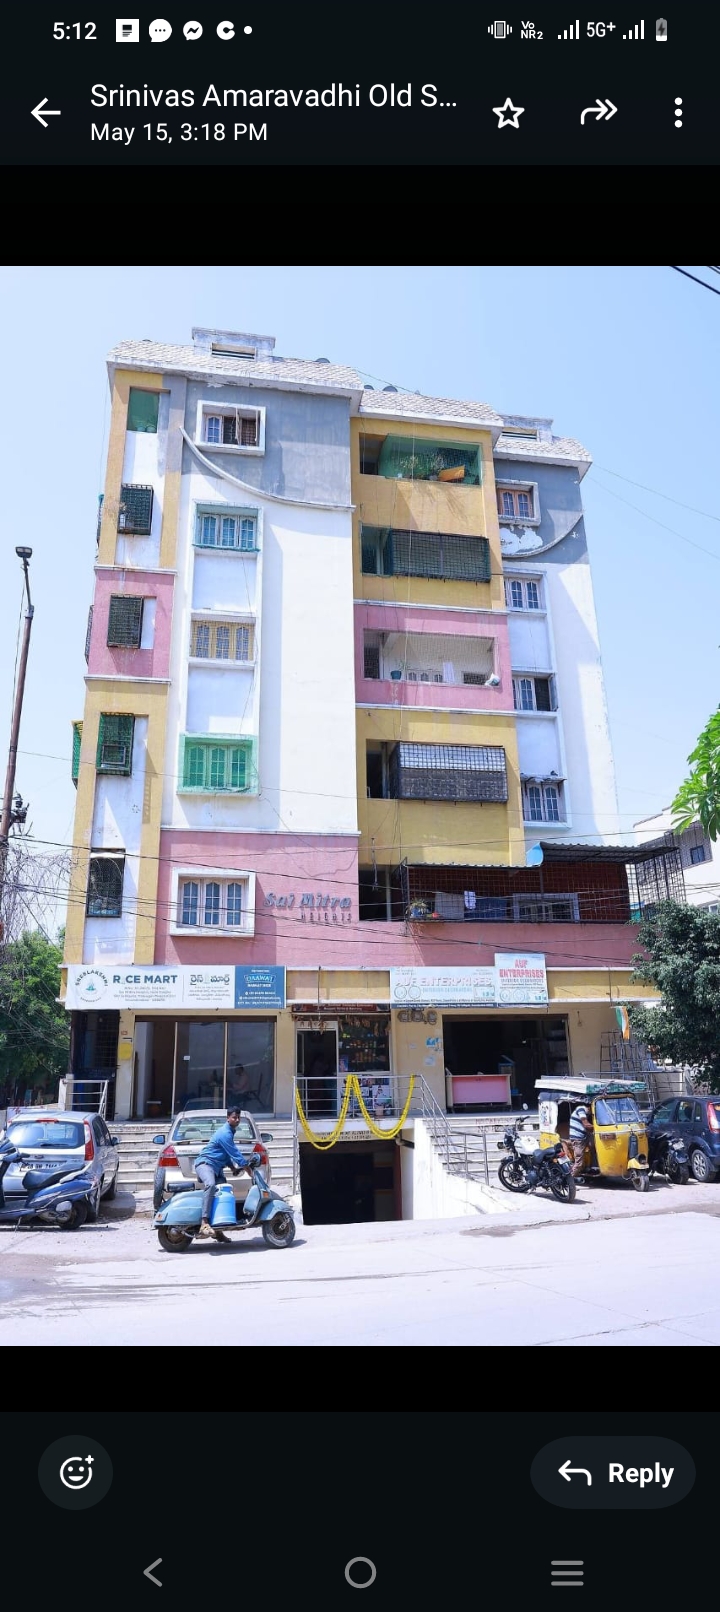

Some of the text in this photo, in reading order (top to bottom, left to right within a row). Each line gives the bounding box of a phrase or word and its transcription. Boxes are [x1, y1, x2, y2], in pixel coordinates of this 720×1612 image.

[264, 893, 352, 909] Sai Mitra
[499, 969, 544, 978] ENTERPRISES
[112, 974, 178, 984] RCE MART
[420, 976, 493, 987] ENTERPRISES
